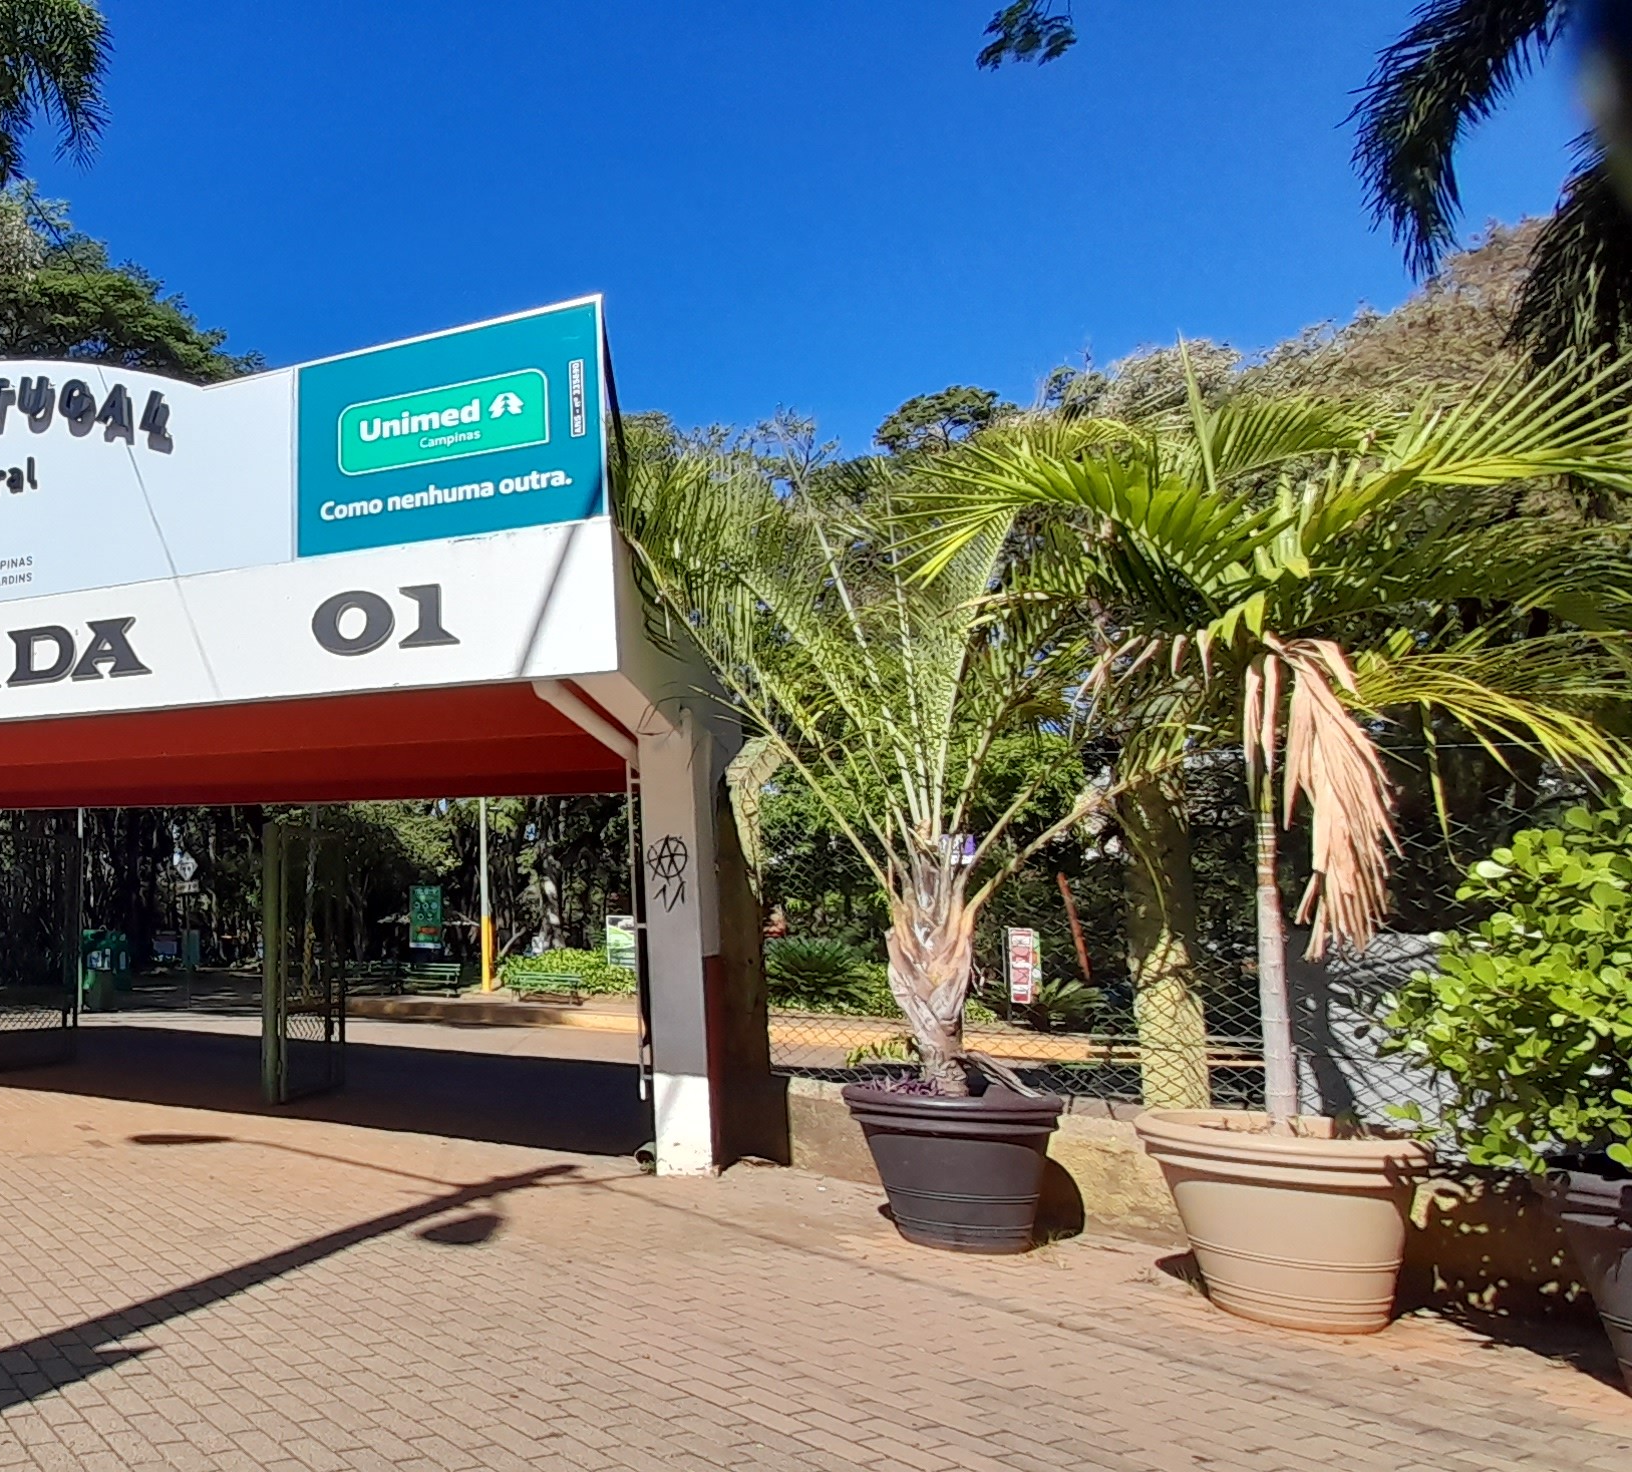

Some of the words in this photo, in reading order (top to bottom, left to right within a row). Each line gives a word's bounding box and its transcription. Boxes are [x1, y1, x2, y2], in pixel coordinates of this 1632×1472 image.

[359, 399, 480, 442] Unimed
[419, 428, 481, 449] Campinas
[320, 498, 383, 522] Como
[386, 480, 495, 511] nenhuma
[498, 467, 573, 495] outra.
[311, 583, 461, 657] 01
